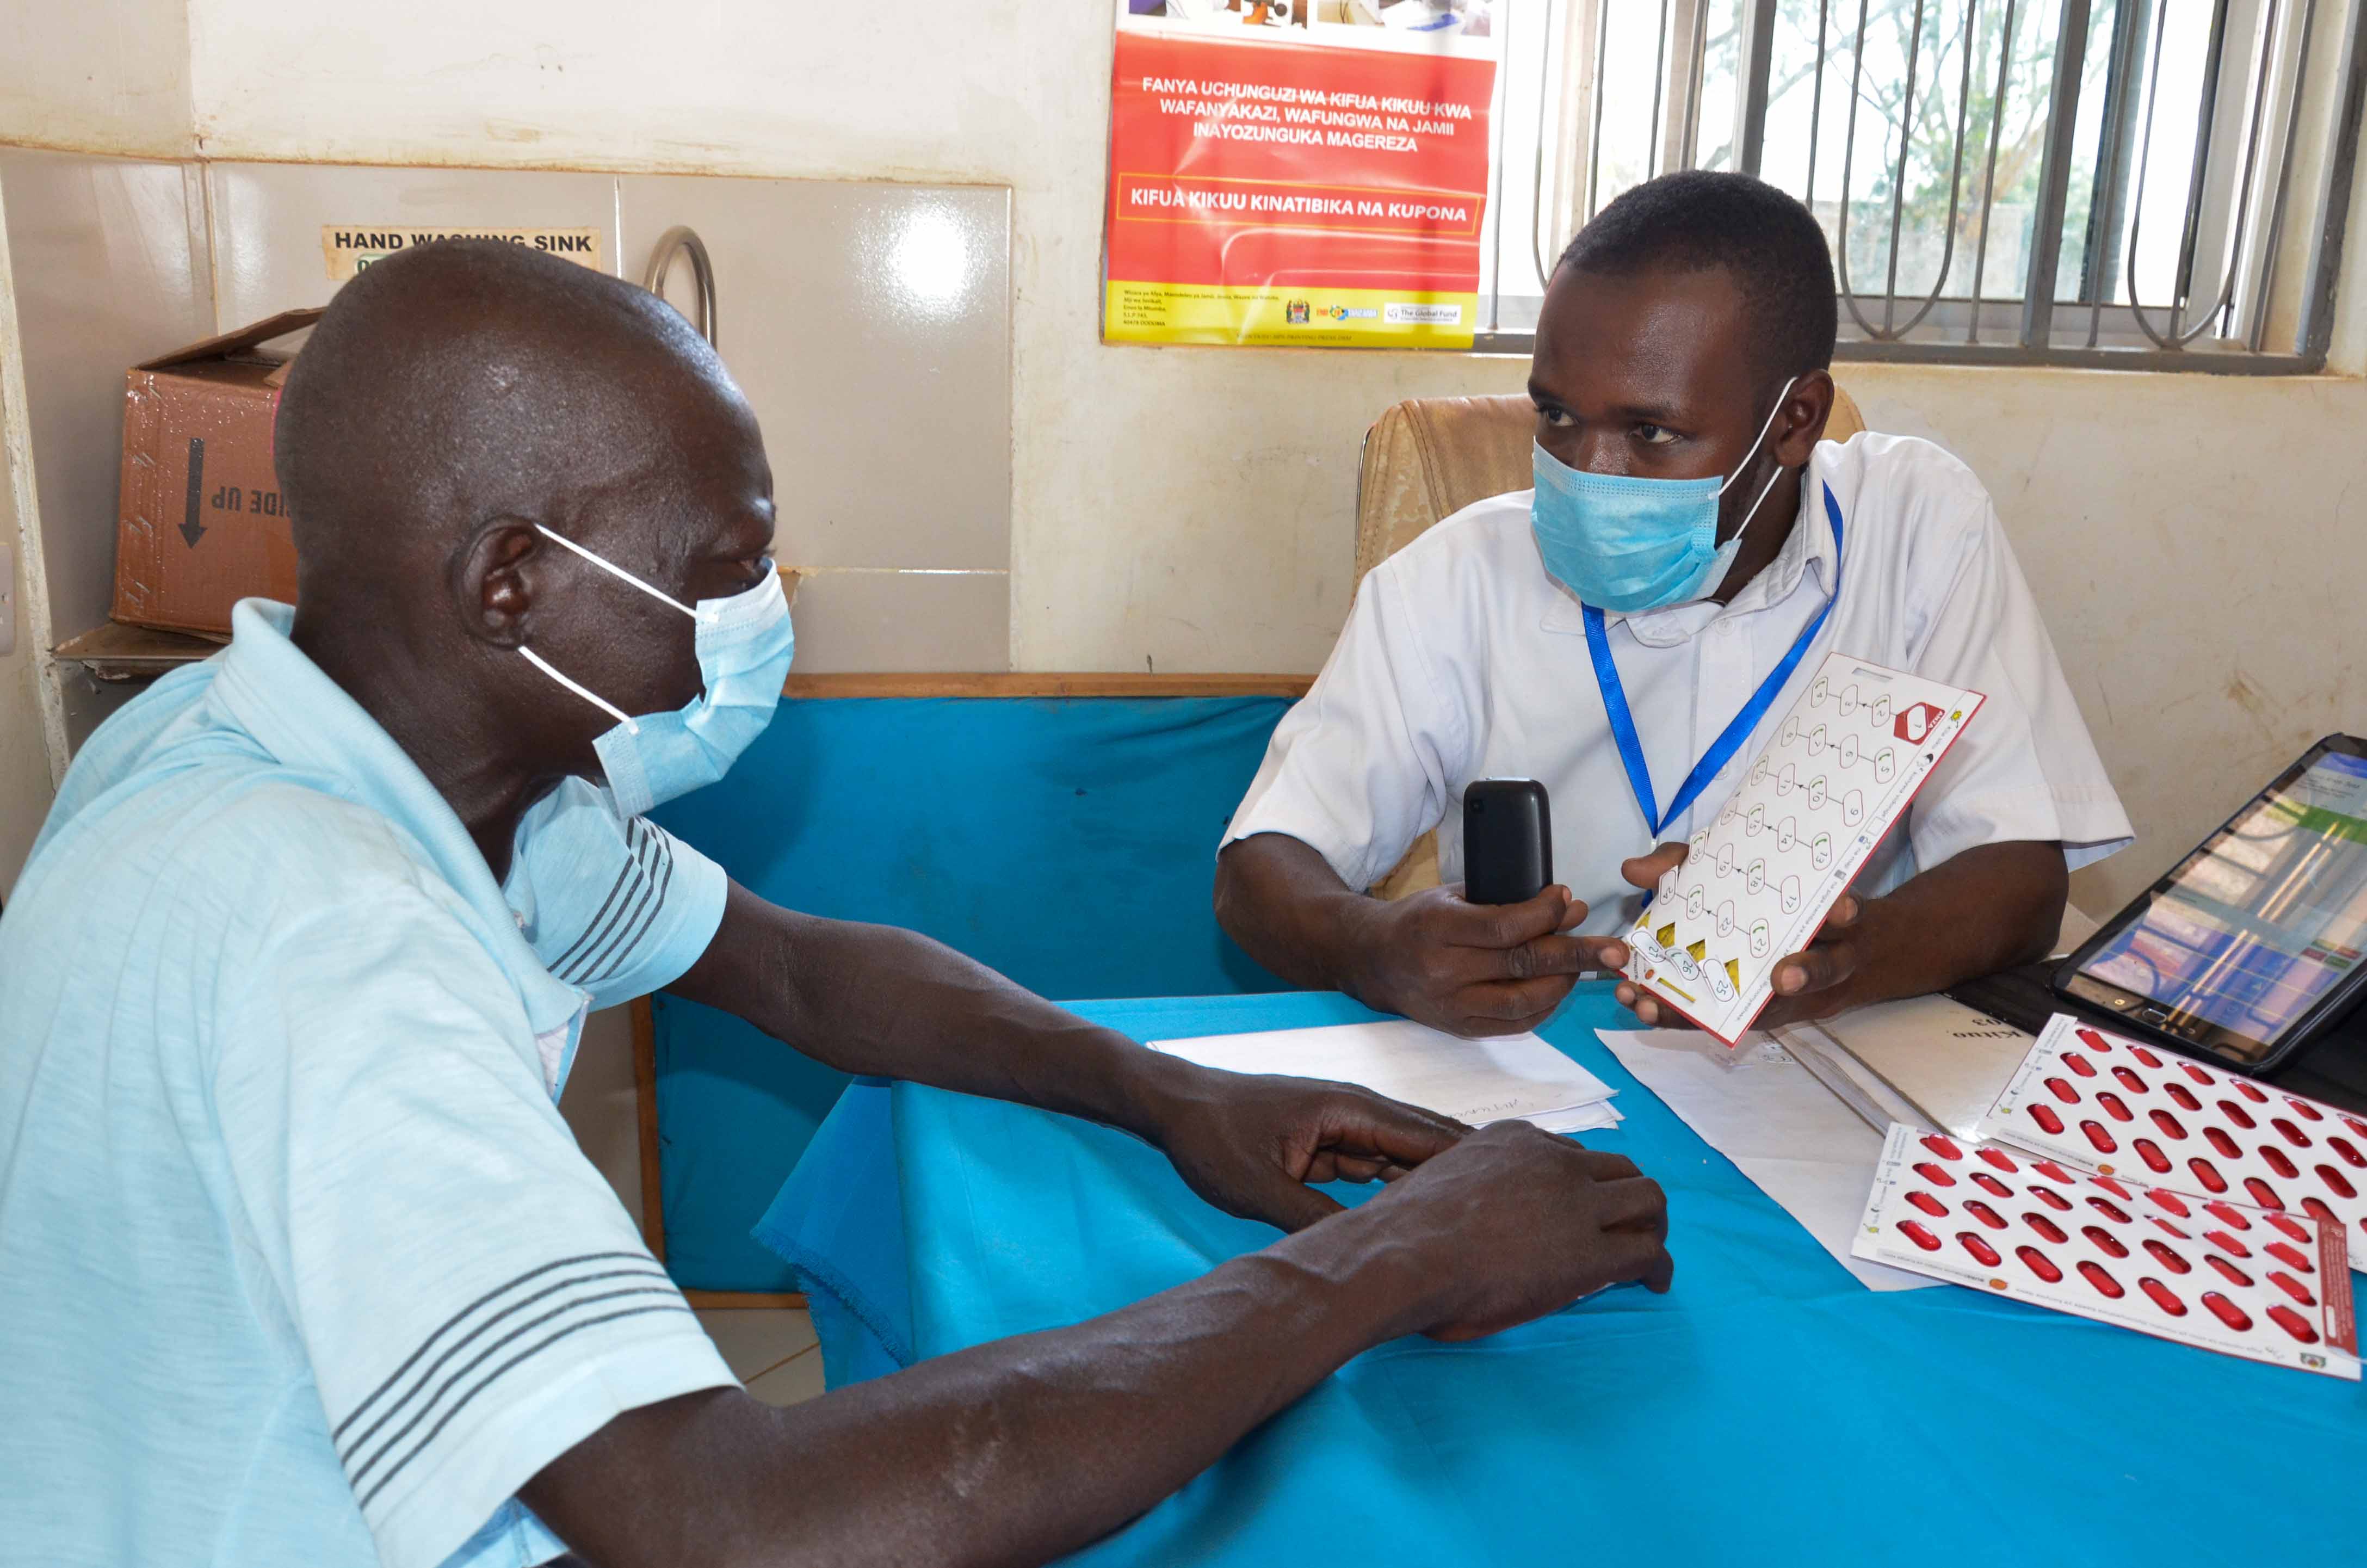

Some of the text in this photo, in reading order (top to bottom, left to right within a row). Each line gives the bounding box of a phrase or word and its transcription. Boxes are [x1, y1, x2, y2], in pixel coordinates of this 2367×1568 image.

[1142, 77, 1472, 120] FANYA UCHUNGUZI WA KIFUA KIKUU KWA
[1160, 98, 1454, 135] WAFANYAKAZI, WAFUNGWA NA JAMII
[1194, 122, 1418, 152] INAYOZUNGUKA MAGEREZA
[1131, 188, 1467, 221] KIFUA KIKUU KINATIBIKA NA KUPONA
[335, 232, 403, 249] HAND
[534, 235, 592, 252] SINK
[1415, 309, 1438, 317] Global
[1439, 310, 1457, 318] Fund
[212, 486, 291, 517] IDE UP
[1927, 711, 1944, 729] ANZA
[1780, 779, 1791, 789] 11
[1812, 791, 1824, 802] 10
[1749, 819, 1760, 830] 15
[1781, 833, 1793, 844] 14
[1692, 848, 1702, 861] 20
[1815, 852, 1828, 863] 13
[1719, 860, 1730, 872] 19
[1750, 875, 1763, 887] 18
[1663, 886, 1673, 900] 24
[1689, 901, 1701, 915] 23
[1785, 895, 1797, 908] 17
[1719, 917, 1732, 931] 22
[1753, 937, 1767, 952] 21
[1649, 946, 1659, 958] 27
[1682, 960, 1694, 974] 26
[1716, 979, 1729, 996] 25
